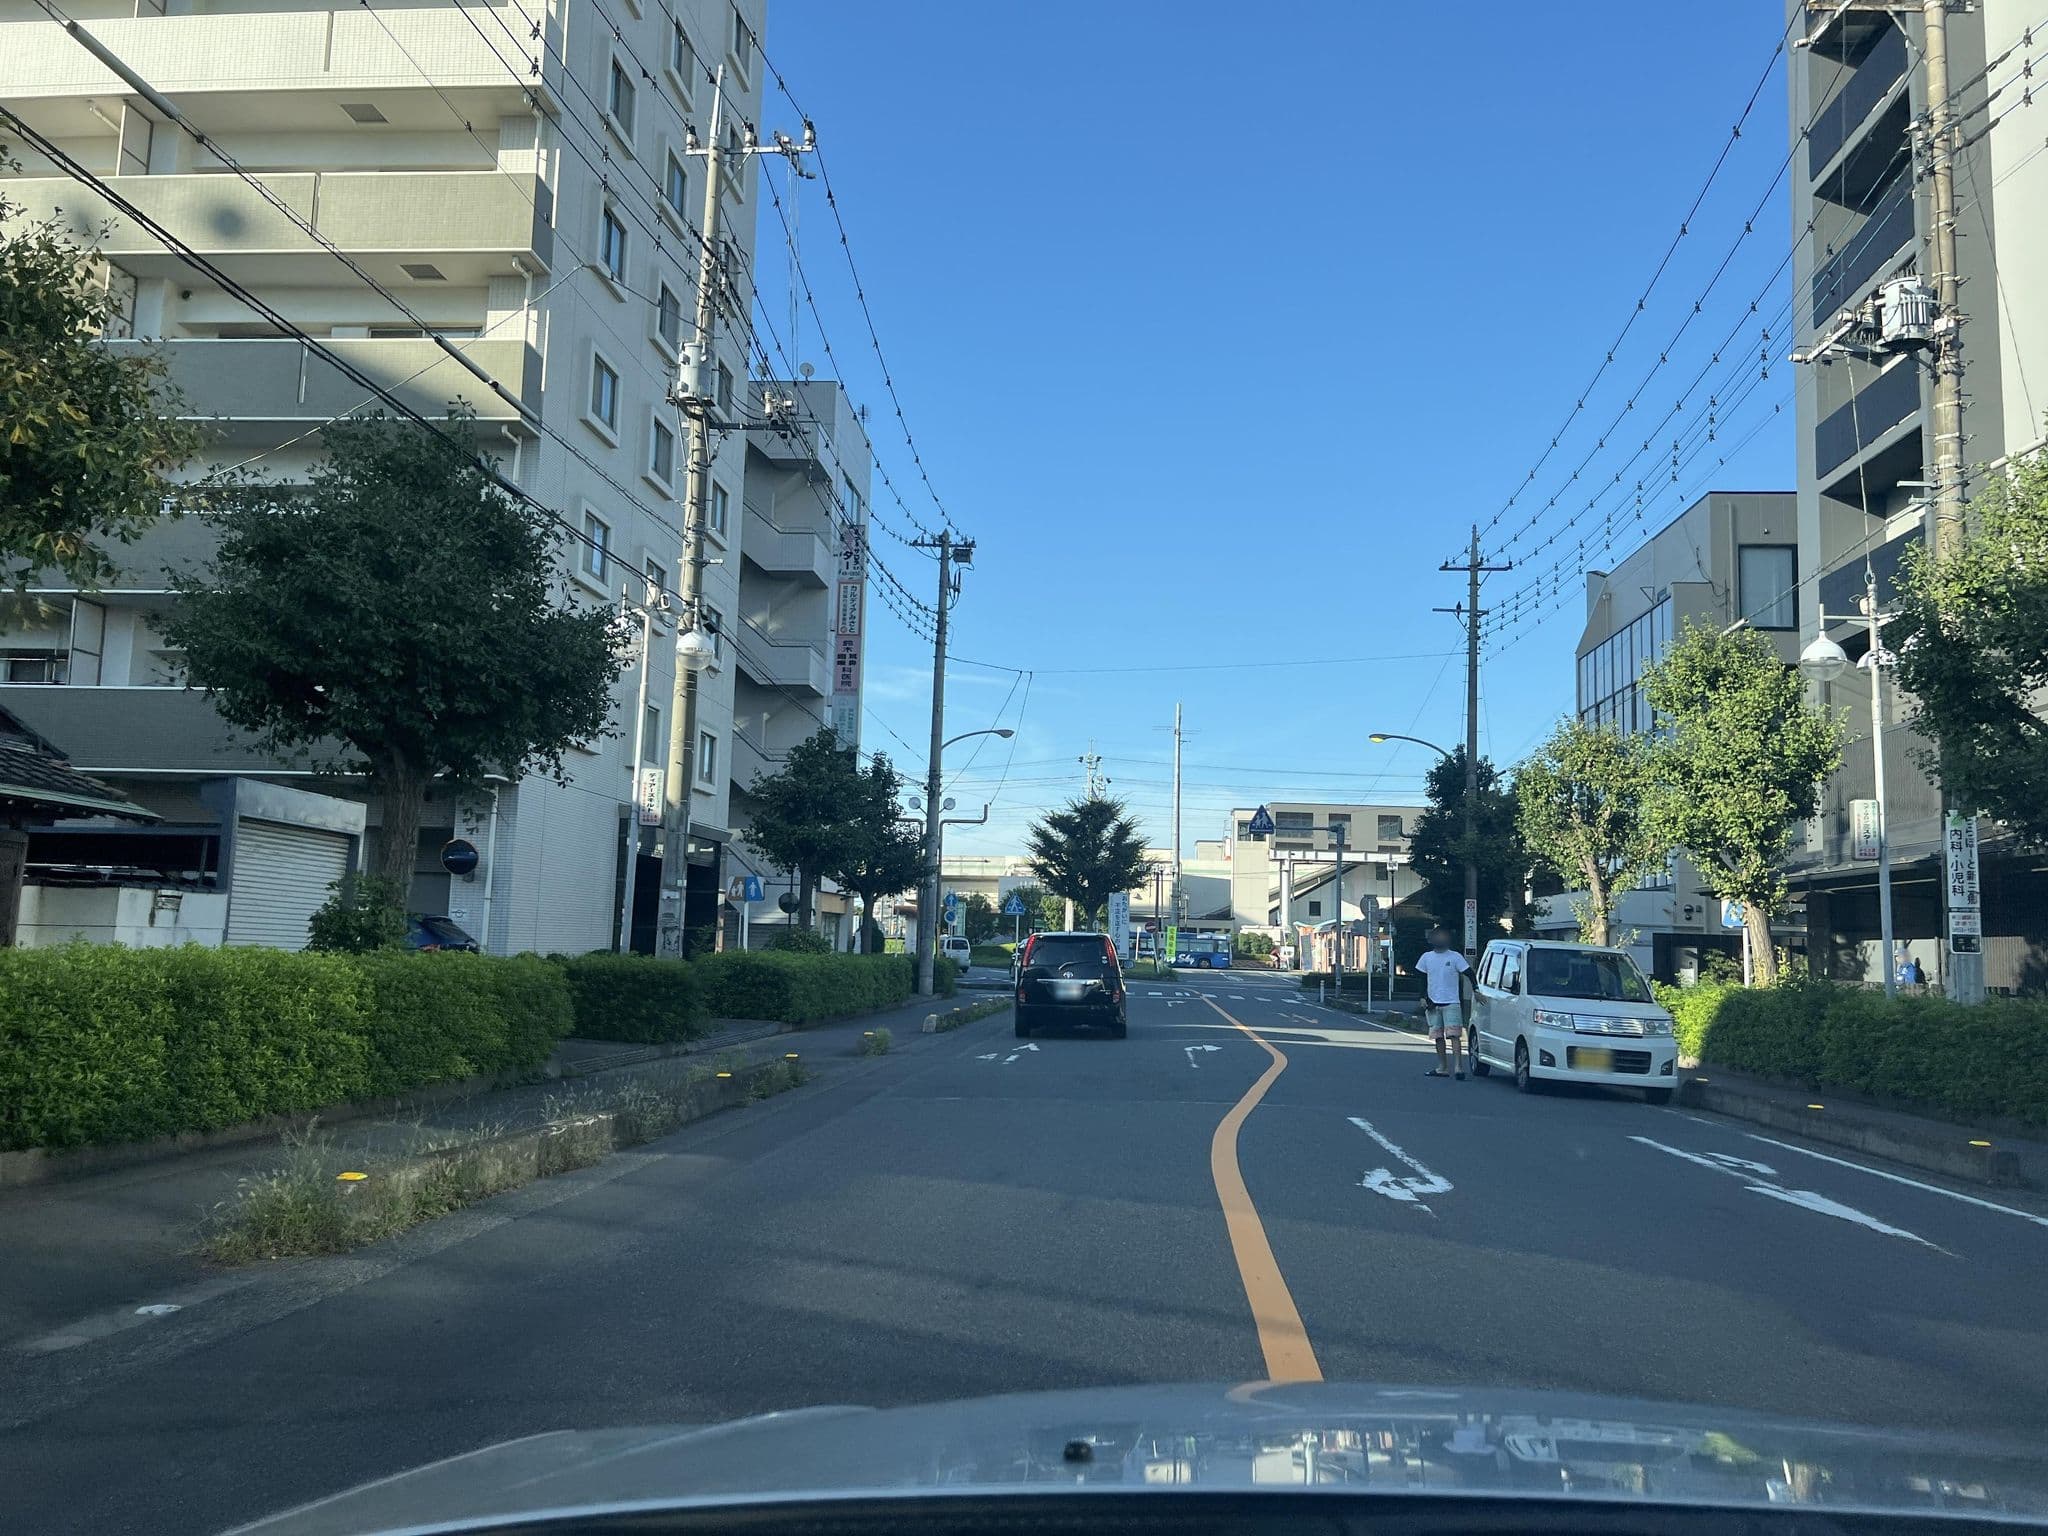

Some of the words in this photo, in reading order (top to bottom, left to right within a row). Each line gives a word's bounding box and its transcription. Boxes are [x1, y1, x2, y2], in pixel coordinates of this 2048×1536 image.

[1949, 829, 1965, 897] 内科・小児科
